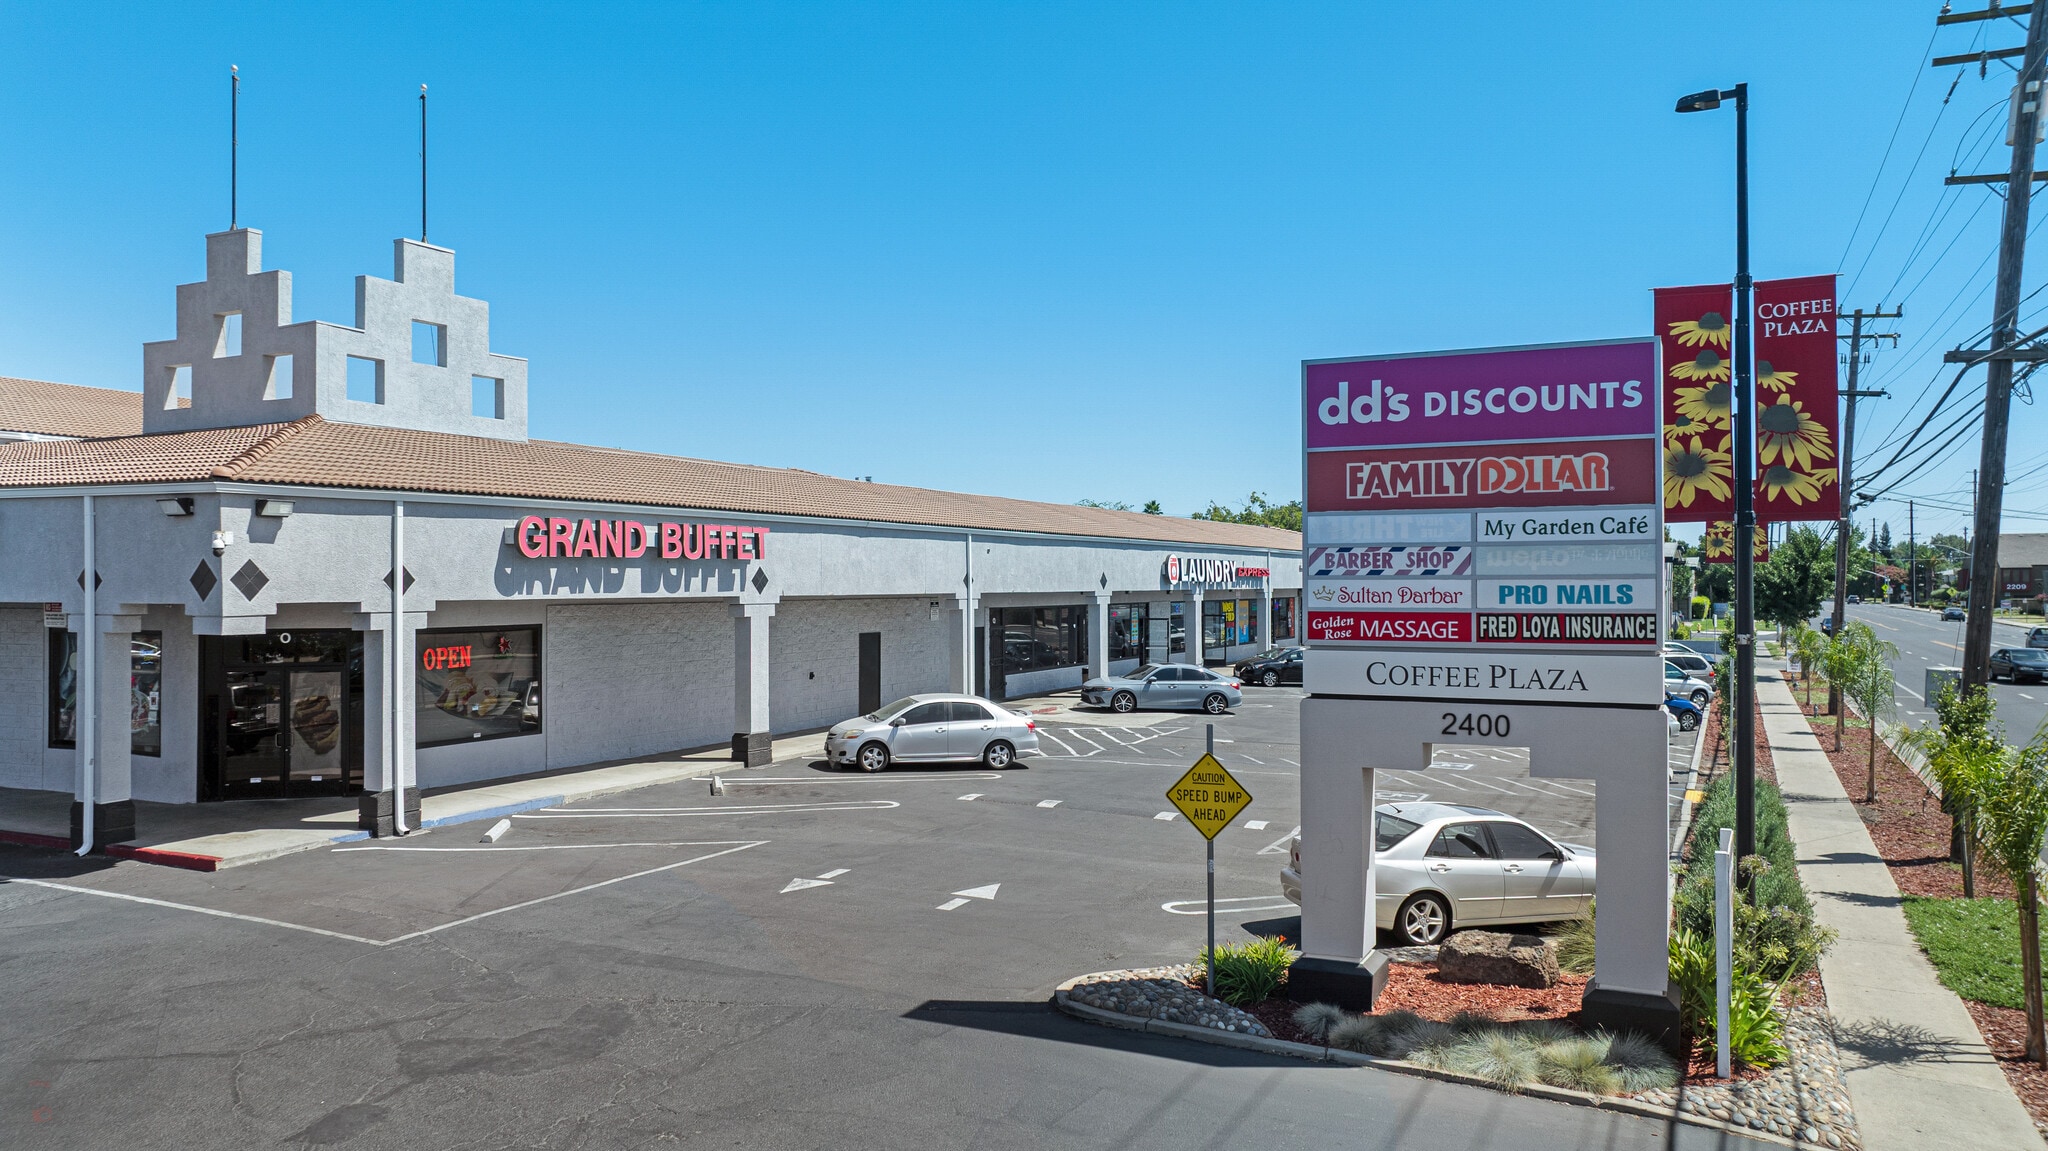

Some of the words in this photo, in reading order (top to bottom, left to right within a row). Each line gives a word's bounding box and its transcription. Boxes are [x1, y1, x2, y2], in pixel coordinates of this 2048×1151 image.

[1757, 299, 1833, 320] COFFEE
[1764, 318, 1829, 338] PLAZA
[1317, 379, 1410, 425] dd's
[1424, 380, 1643, 418] DISCOUNTS
[1346, 458, 1476, 500] FAMILY
[1477, 452, 1610, 495] DOLLAR
[514, 515, 648, 559] GRAND
[658, 522, 770, 560] BUFFET
[1484, 520, 1515, 540] My
[1522, 517, 1595, 536] Garden
[1600, 516, 1649, 535] Café
[1180, 558, 1237, 583] LAUNDRY
[1237, 567, 1270, 577] EXPRESS
[1324, 551, 1394, 570] BARBER
[1405, 551, 1455, 570] SHOP
[1337, 586, 1393, 604] Sultan
[1398, 586, 1463, 604] Darbar
[1499, 584, 1548, 605] PRO
[1557, 583, 1633, 605] NAILS
[1312, 616, 1355, 631] Golden
[1323, 627, 1353, 640] Rose
[1360, 619, 1459, 639] MASSAGE
[1479, 615, 1518, 639] FRED
[1521, 615, 1561, 639] LOYA
[1565, 615, 1656, 639] INSURANCE
[423, 645, 472, 670] OPEN
[1366, 661, 1480, 688] COFFEE
[1488, 664, 1589, 691] PLAZA
[1441, 712, 1511, 737] 2400
[1191, 772, 1225, 783] CAUTION
[1176, 789, 1209, 802] SPEED
[1214, 790, 1243, 803] BUMP
[1193, 808, 1226, 821] AHEAD
